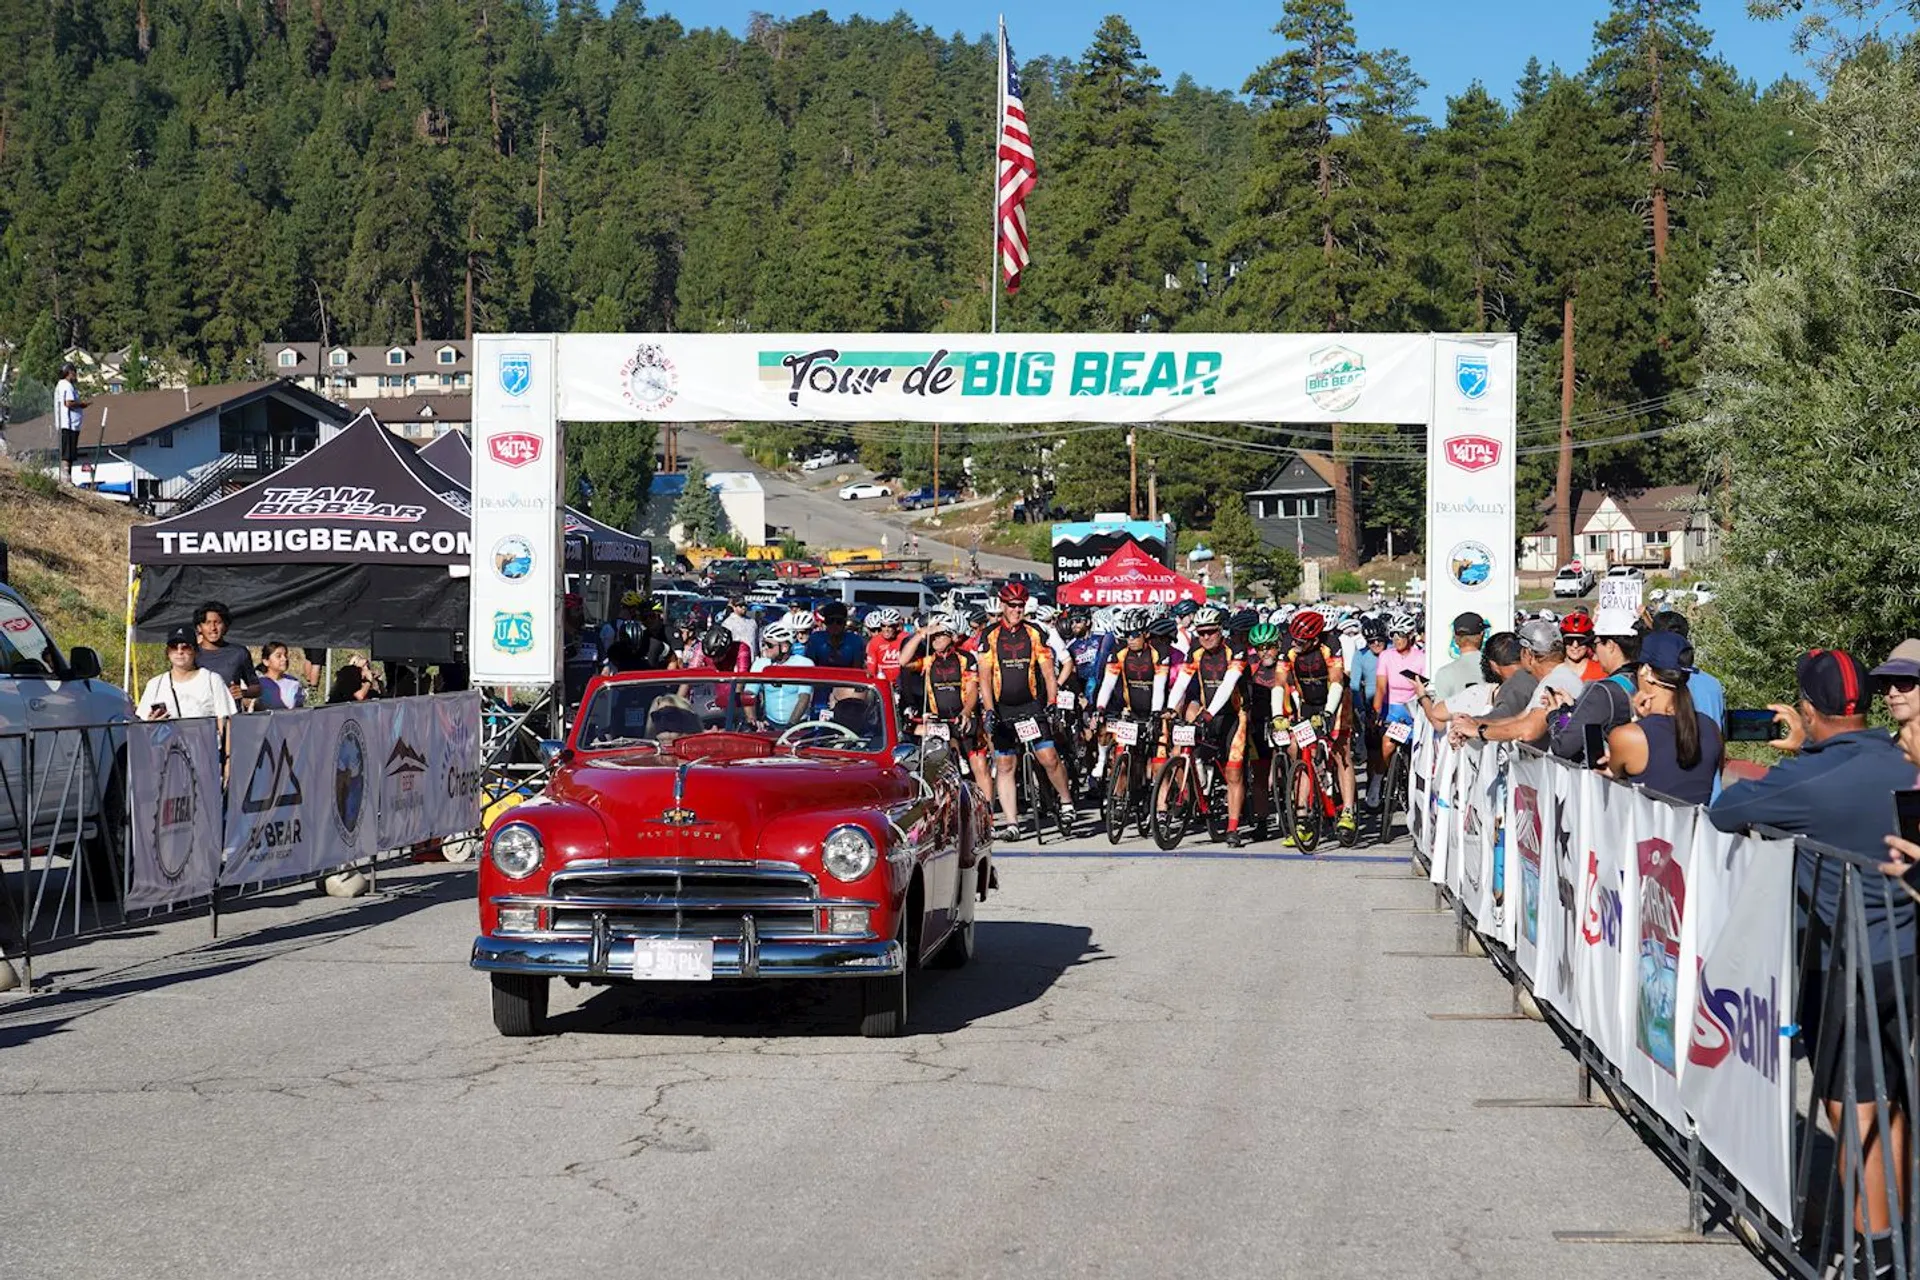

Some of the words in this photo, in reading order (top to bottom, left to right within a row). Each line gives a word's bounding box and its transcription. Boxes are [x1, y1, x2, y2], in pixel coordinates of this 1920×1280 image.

[782, 349, 892, 406] Tour
[902, 349, 957, 396] de
[961, 352, 1057, 396] BIG
[1069, 351, 1223, 396] BEAR
[1309, 378, 1329, 390] BIG
[263, 486, 375, 504] TEAM
[156, 527, 473, 555] TEAMBIGBEAR.COM
[1058, 556, 1083, 568] Bear
[1600, 581, 1616, 595] RIDE
[1619, 581, 1641, 595] THAT
[1096, 589, 1143, 603] FIRST
[1147, 589, 1177, 603] AID
[1601, 595, 1638, 610] GRAVEL
[265, 819, 302, 847] BEAR
[637, 830, 722, 841] PLYMOUTH
